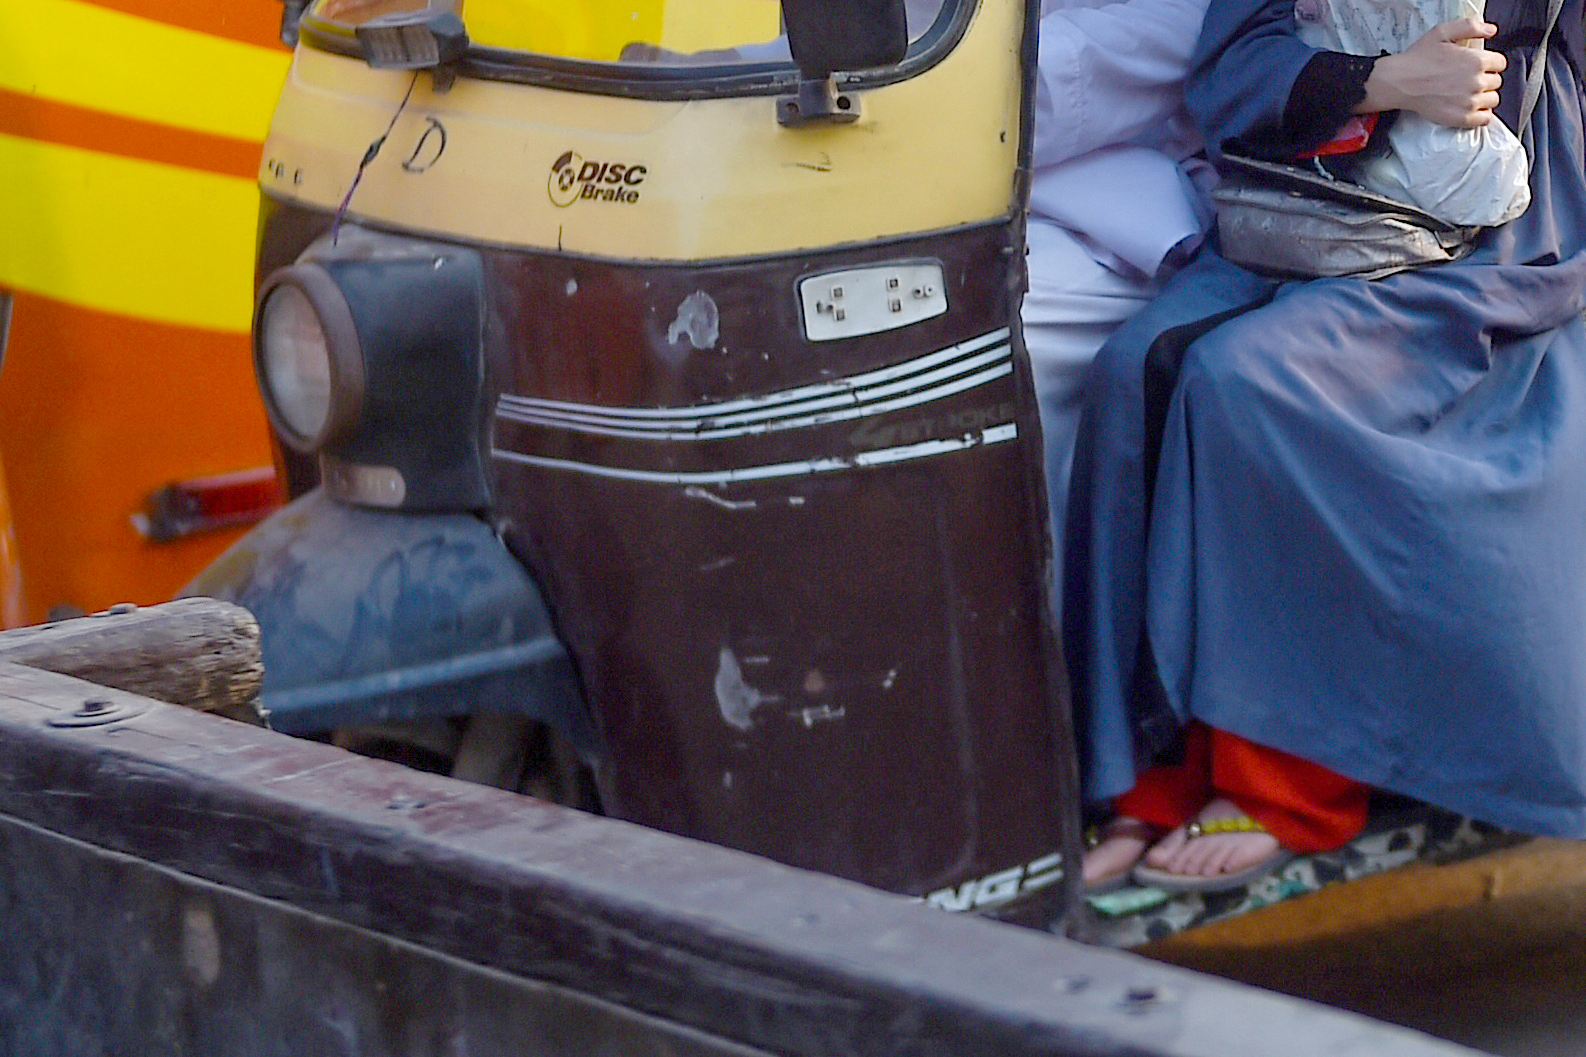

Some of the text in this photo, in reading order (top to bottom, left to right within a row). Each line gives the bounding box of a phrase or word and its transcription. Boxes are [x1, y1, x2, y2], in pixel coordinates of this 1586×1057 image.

[577, 161, 647, 185] DISC
[580, 183, 639, 204] Brake
[912, 864, 1025, 912] NG
